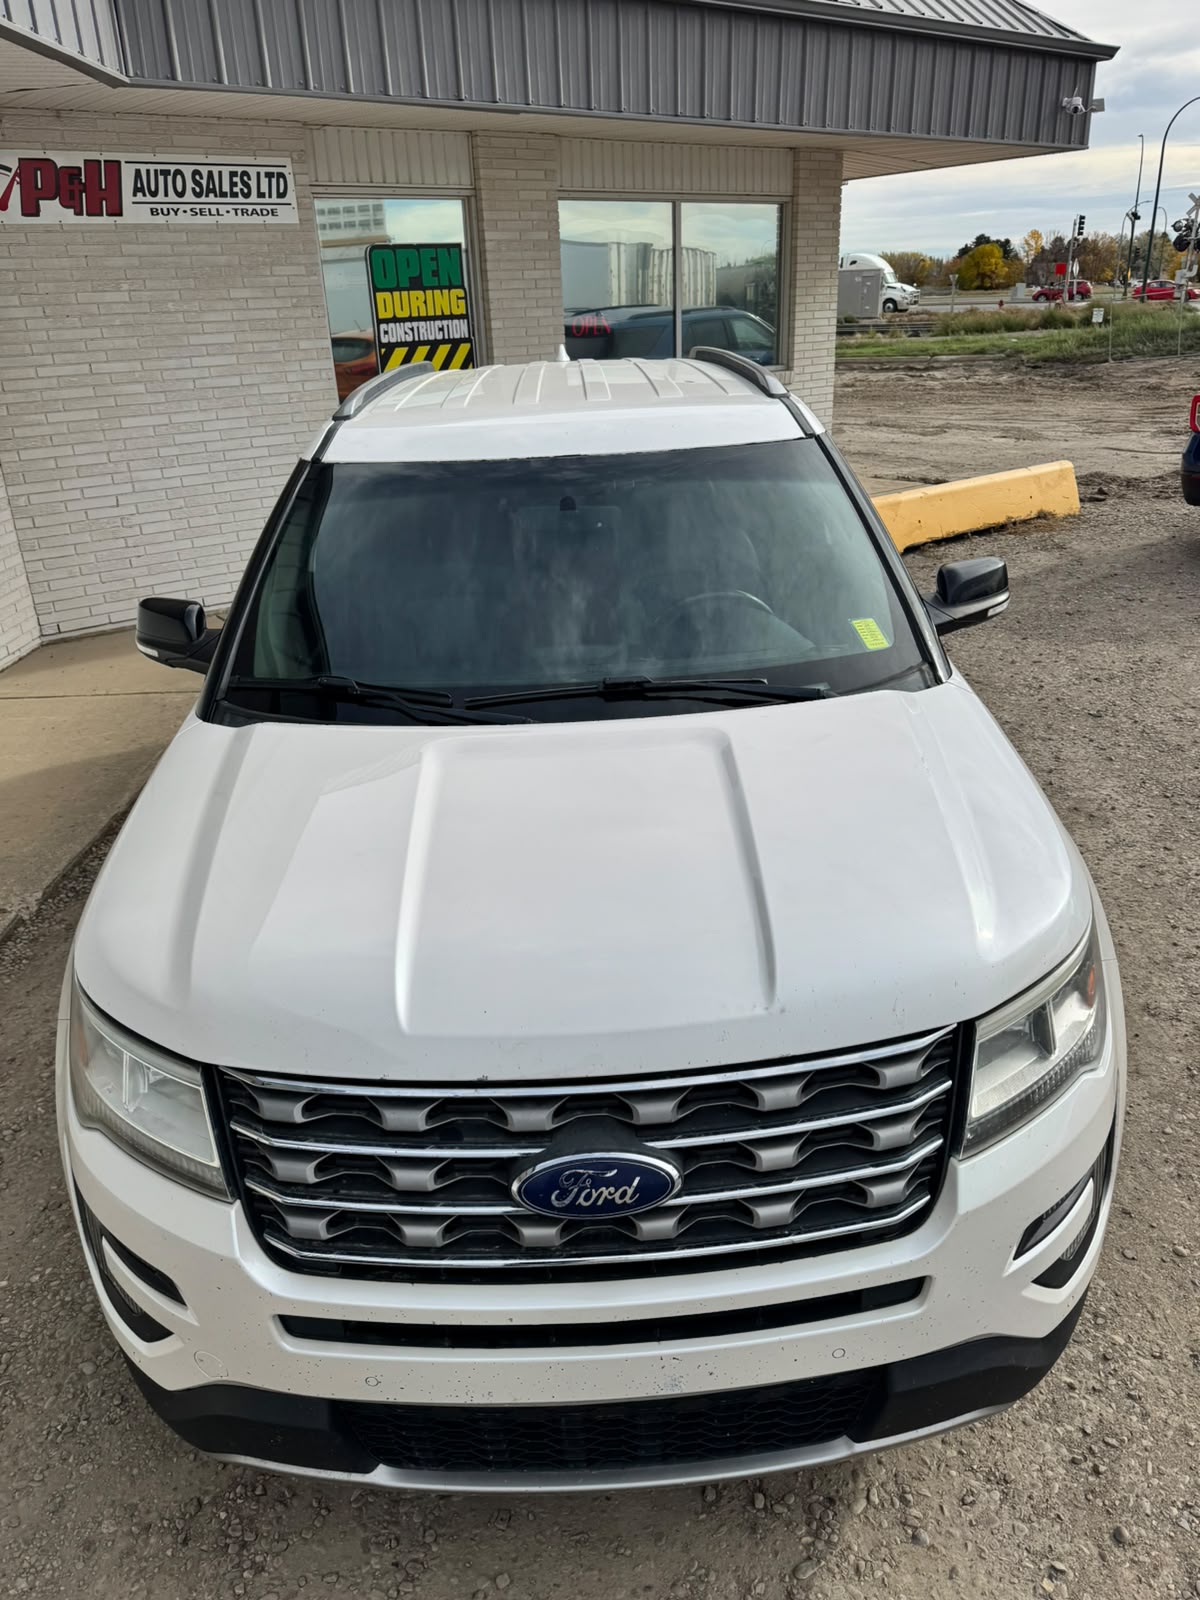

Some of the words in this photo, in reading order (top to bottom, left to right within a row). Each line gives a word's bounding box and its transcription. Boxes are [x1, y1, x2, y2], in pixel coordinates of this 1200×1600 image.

[18, 158, 123, 217] P&H
[132, 168, 187, 198] AUTO
[191, 169, 252, 199] SALES
[256, 171, 288, 199] LTD
[371, 248, 462, 289] OPEN
[376, 288, 466, 319] DURING
[379, 319, 469, 343] CONSTRUCTION
[571, 315, 611, 337] OPEN
[551, 1169, 640, 1208] Ford
